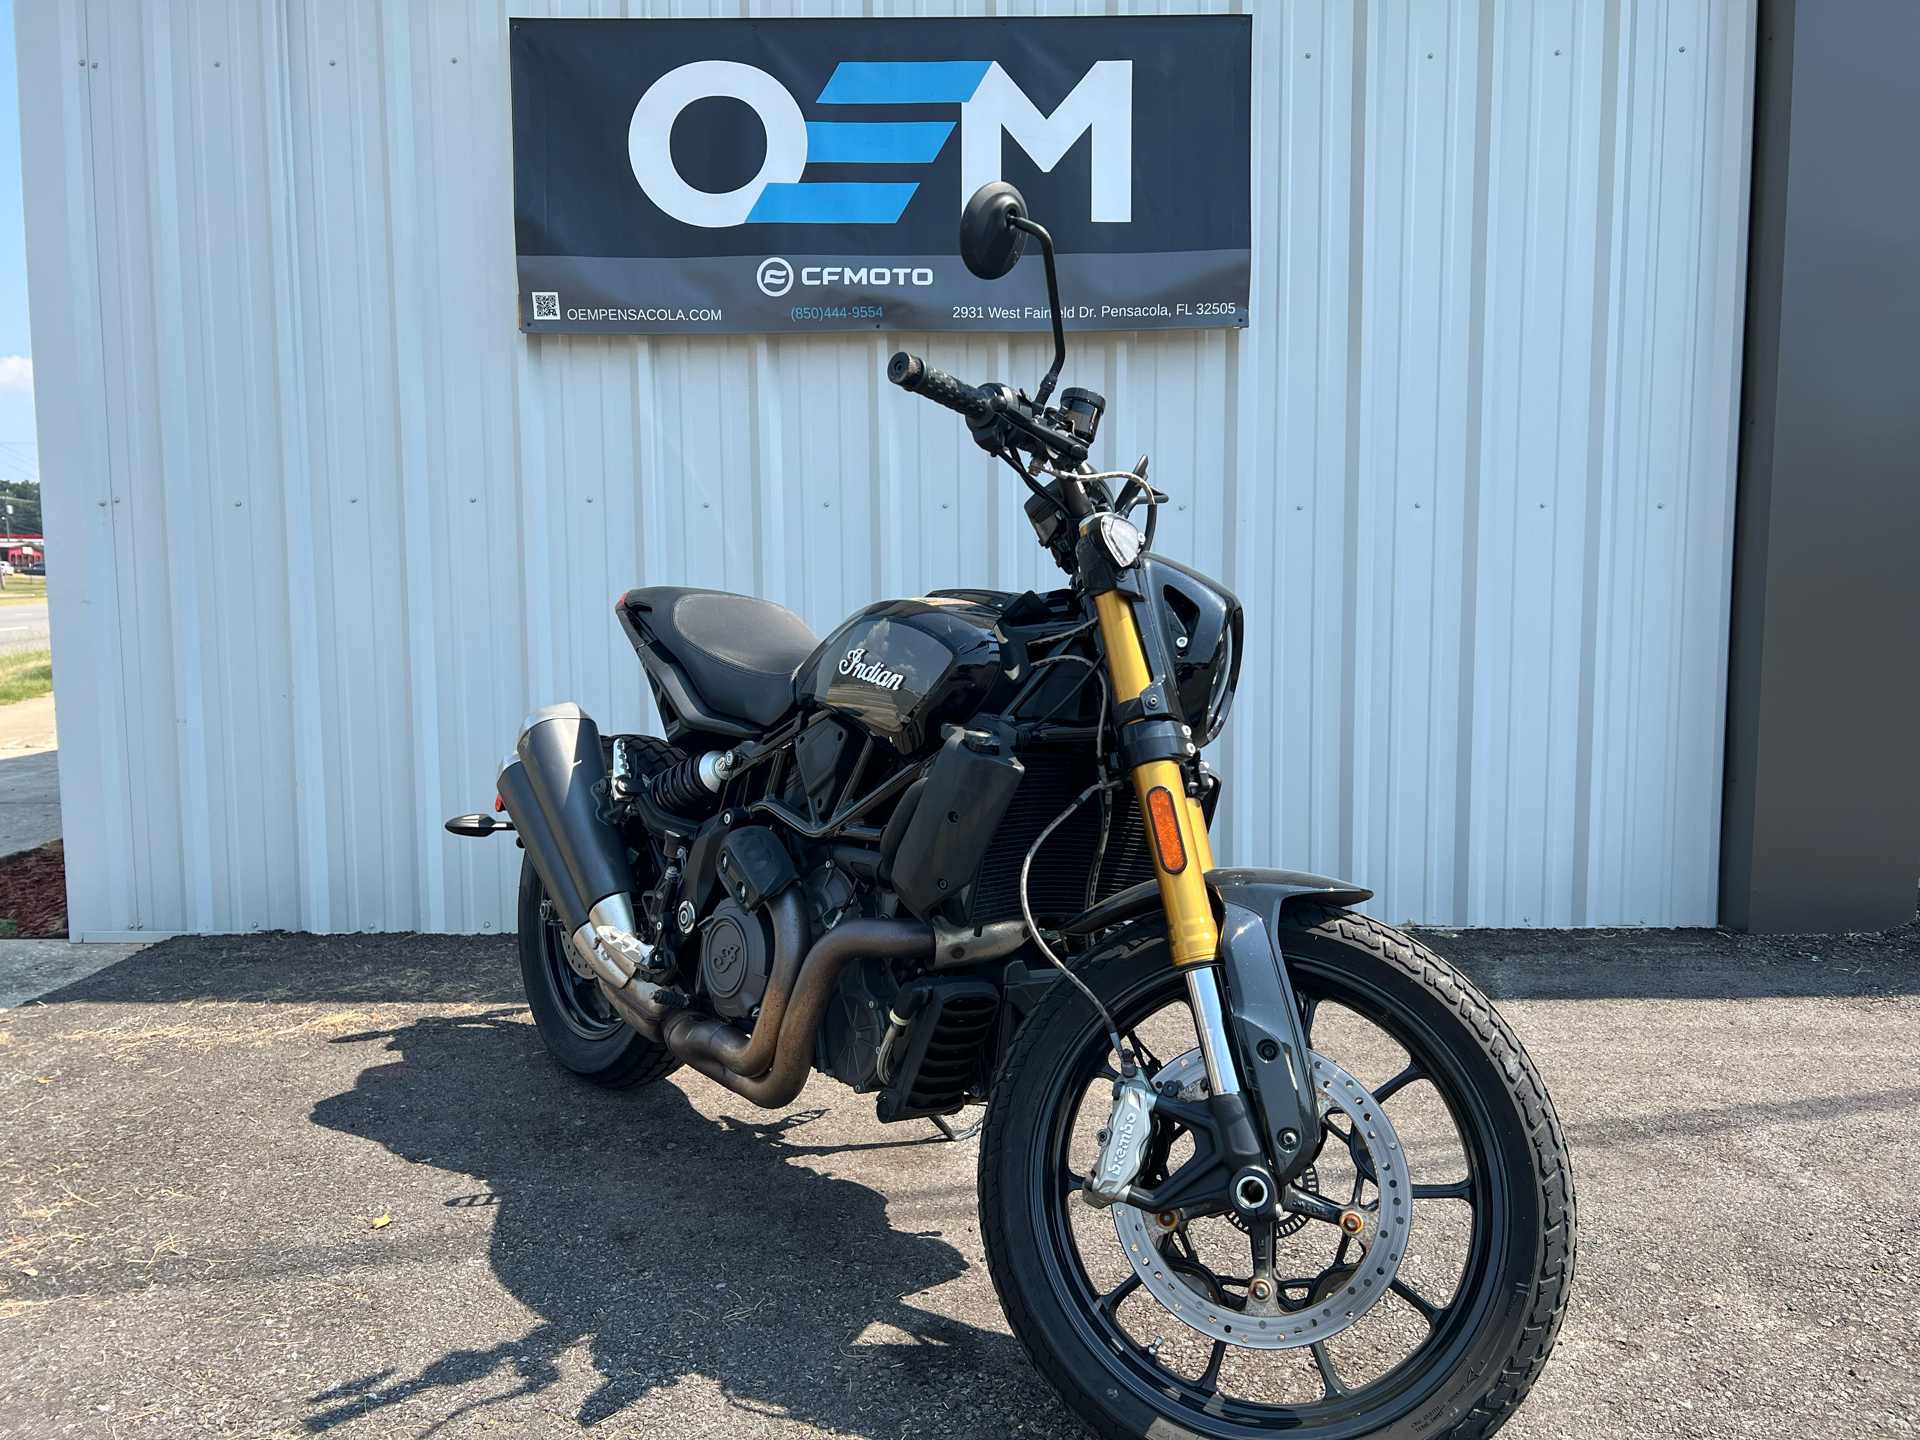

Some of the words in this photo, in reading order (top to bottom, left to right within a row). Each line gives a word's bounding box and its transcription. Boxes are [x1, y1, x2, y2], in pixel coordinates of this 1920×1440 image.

[628, 59, 1133, 228] OEM
[801, 267, 934, 286] CFMOTO
[566, 307, 723, 322] OEMPENSACOLA.COM
[790, 306, 884, 322] (850)444-9554
[952, 306, 984, 319] 2931
[988, 307, 1021, 319] West
[1024, 306, 1075, 319] Fairld
[1079, 306, 1097, 318] Dr.
[1101, 304, 1171, 319] Pensacola,
[1176, 303, 1192, 316] FL
[1195, 302, 1236, 315] 32505
[838, 648, 904, 691] Indian
[1107, 1112, 1137, 1176] brembo
